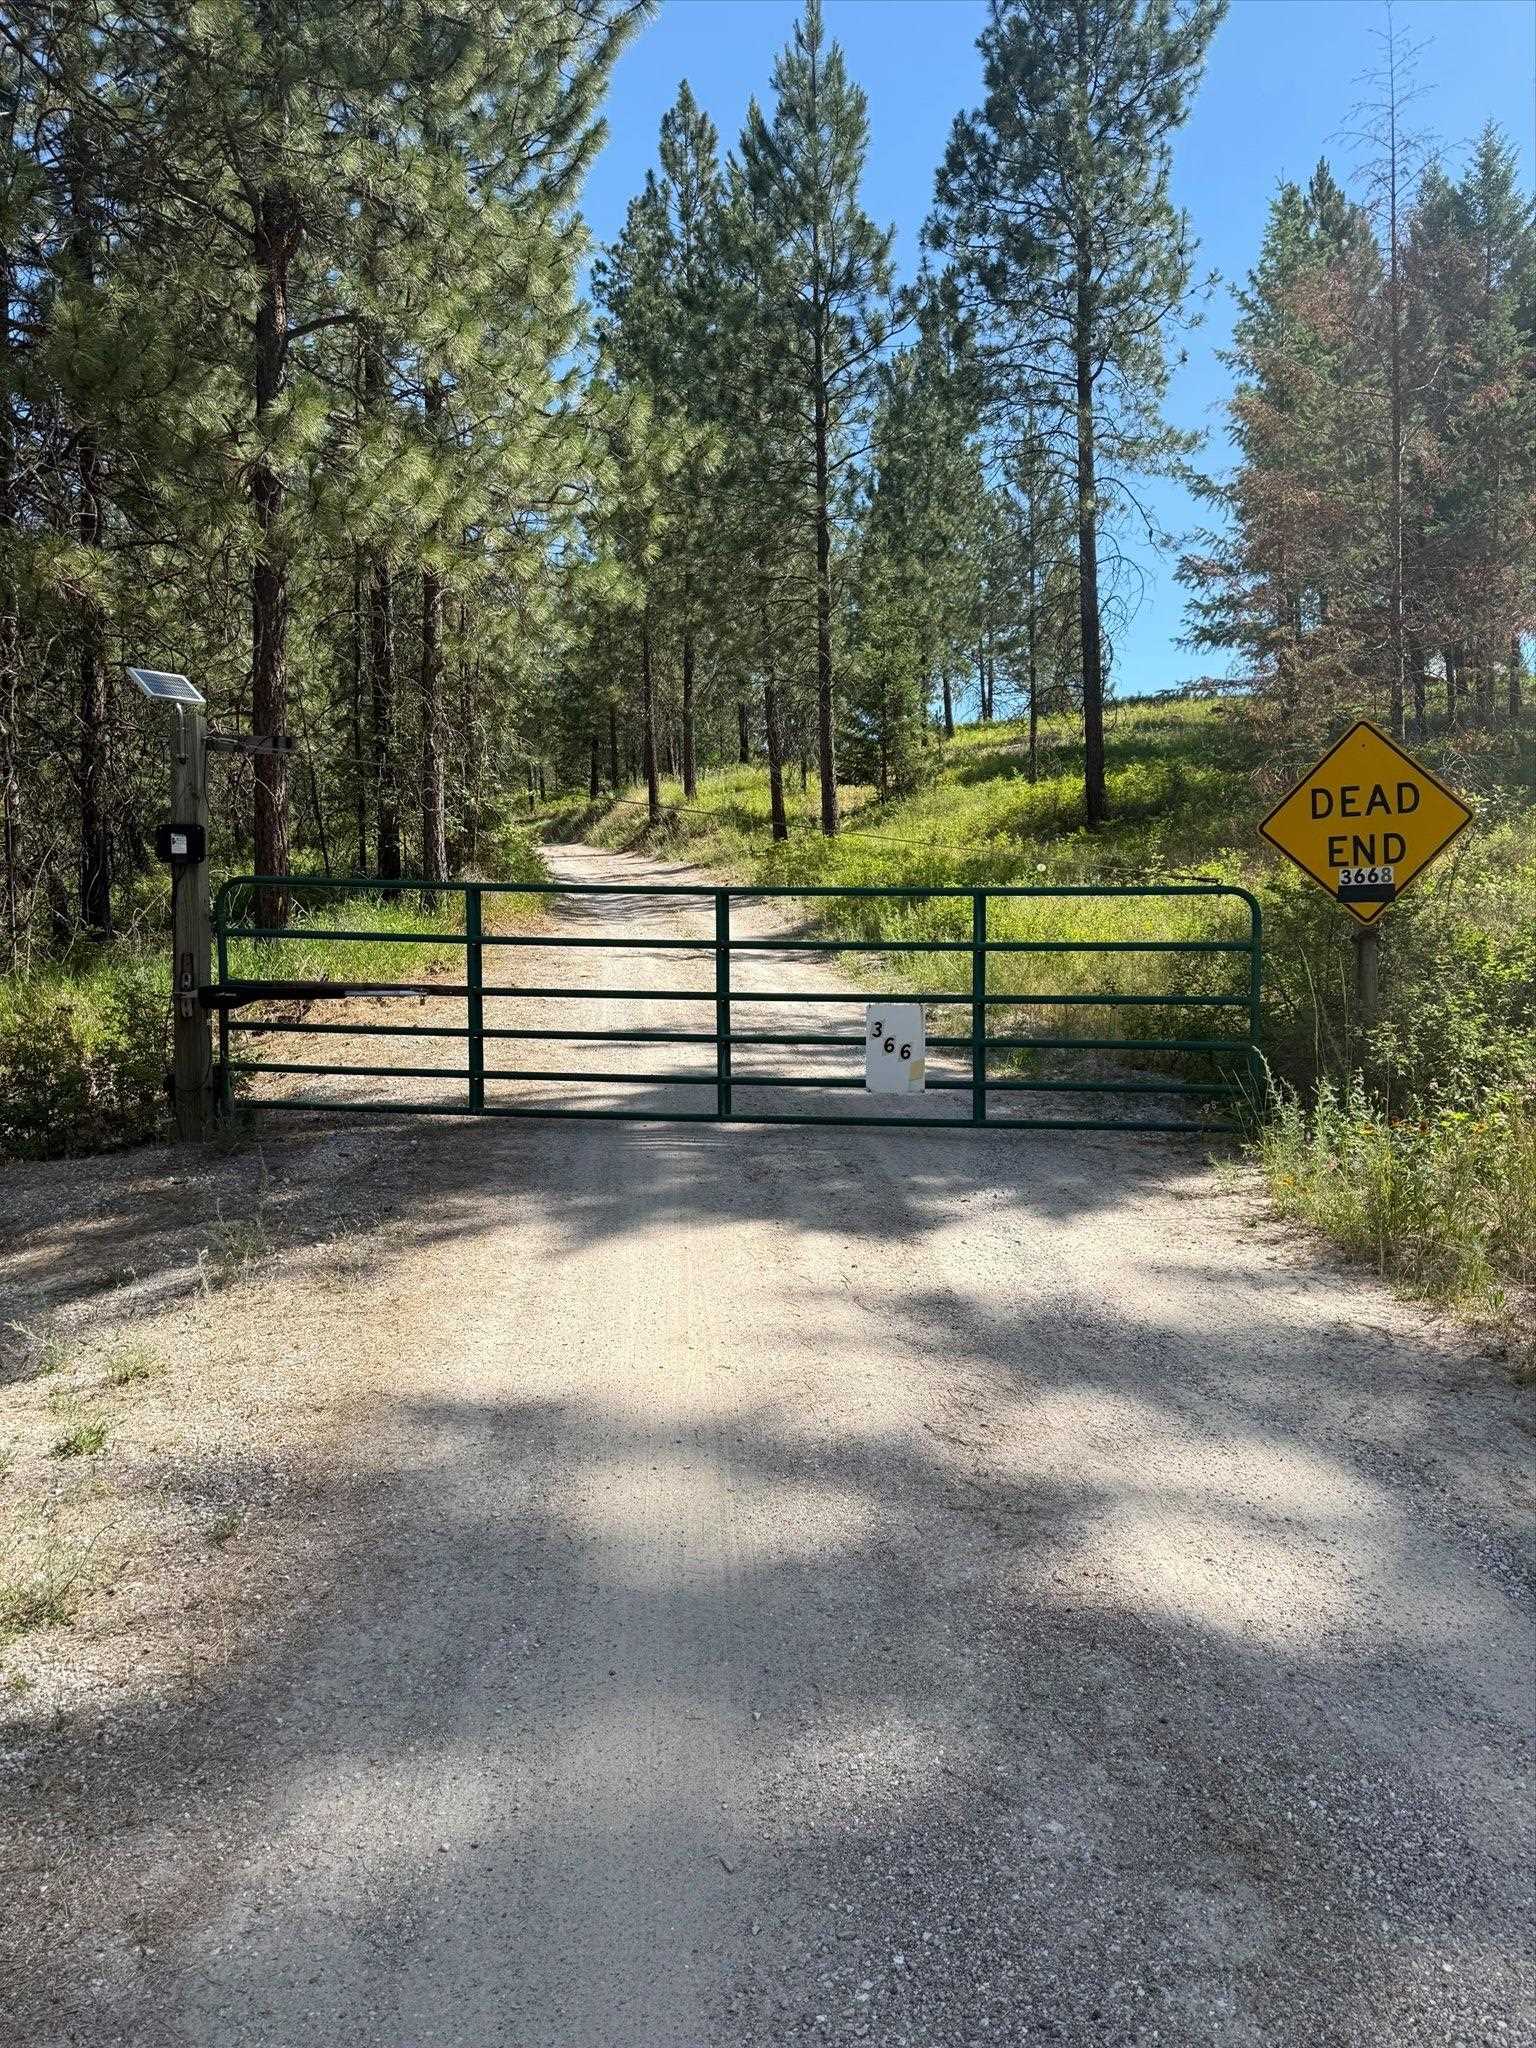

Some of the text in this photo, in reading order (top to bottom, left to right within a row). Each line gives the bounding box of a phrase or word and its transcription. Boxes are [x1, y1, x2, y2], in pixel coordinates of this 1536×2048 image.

[1311, 782, 1420, 820] DEAD
[1328, 833, 1406, 868] END
[1340, 867, 1393, 885] 3668
